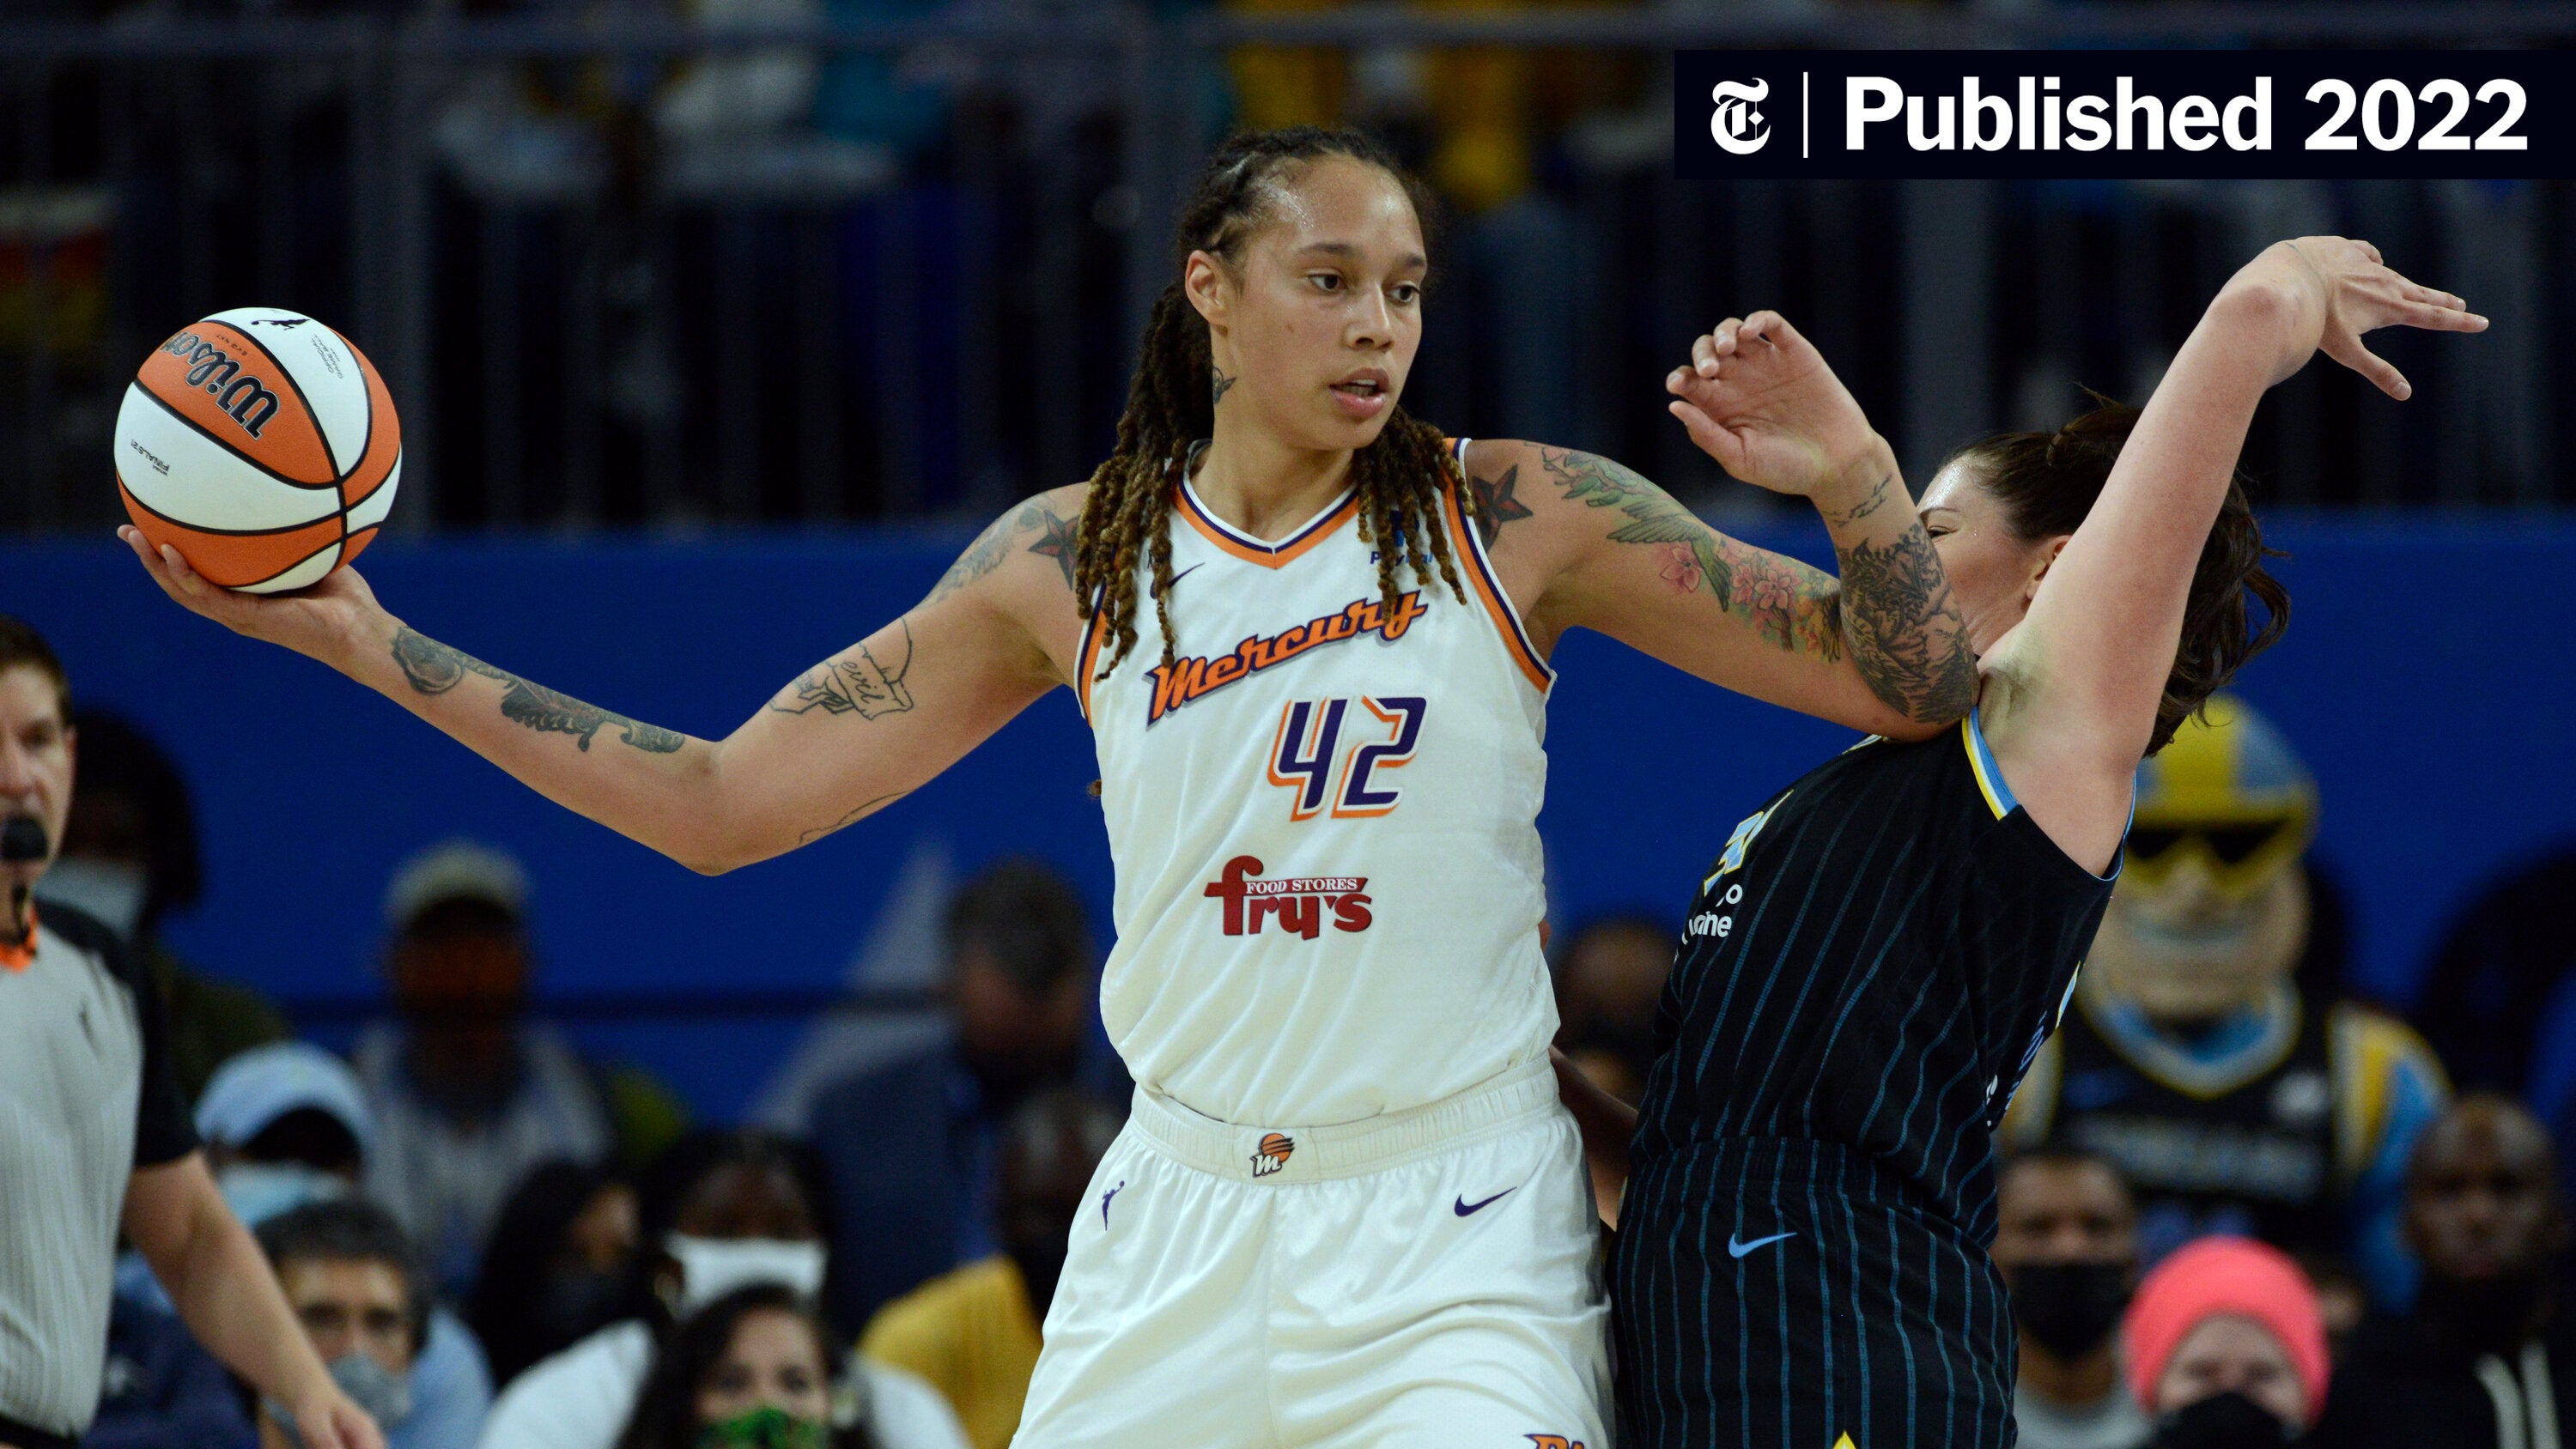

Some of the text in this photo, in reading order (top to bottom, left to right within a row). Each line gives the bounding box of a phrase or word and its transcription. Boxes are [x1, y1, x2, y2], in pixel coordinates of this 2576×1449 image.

[138, 446, 170, 472] FINALS
[1142, 590, 1429, 731] Mercury
[1267, 695, 1427, 822] 42
[1203, 855, 1373, 941] fry's
[1246, 877, 1357, 894] FOOD STORES
